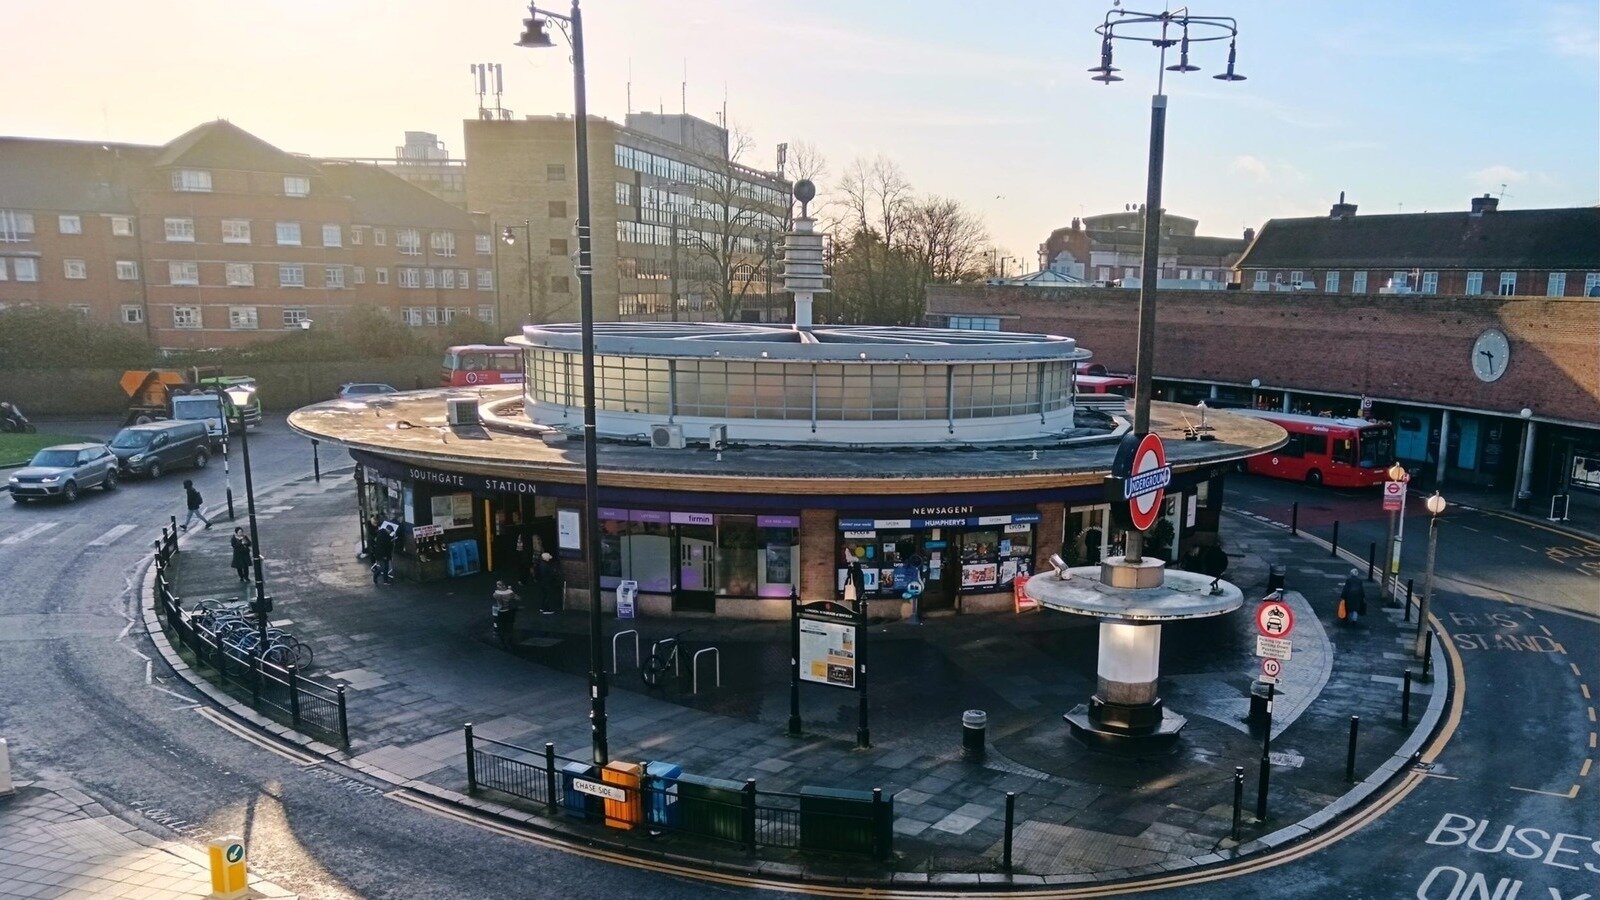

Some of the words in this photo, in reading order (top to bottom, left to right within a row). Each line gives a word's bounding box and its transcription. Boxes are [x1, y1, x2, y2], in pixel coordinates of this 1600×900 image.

[410, 468, 464, 486] SOUTHGATE
[485, 479, 536, 494] STATION
[1124, 466, 1171, 500] UNDERGROUND
[912, 506, 974, 515] NEWSAGENT
[688, 514, 710, 523] firmin
[924, 518, 966, 526] HUMPHERY'S
[1449, 611, 1519, 629] BUS
[1453, 633, 1559, 653] STAND
[1266, 664, 1277, 672] 10
[576, 781, 596, 792] CHASE
[598, 786, 611, 796] SIDE
